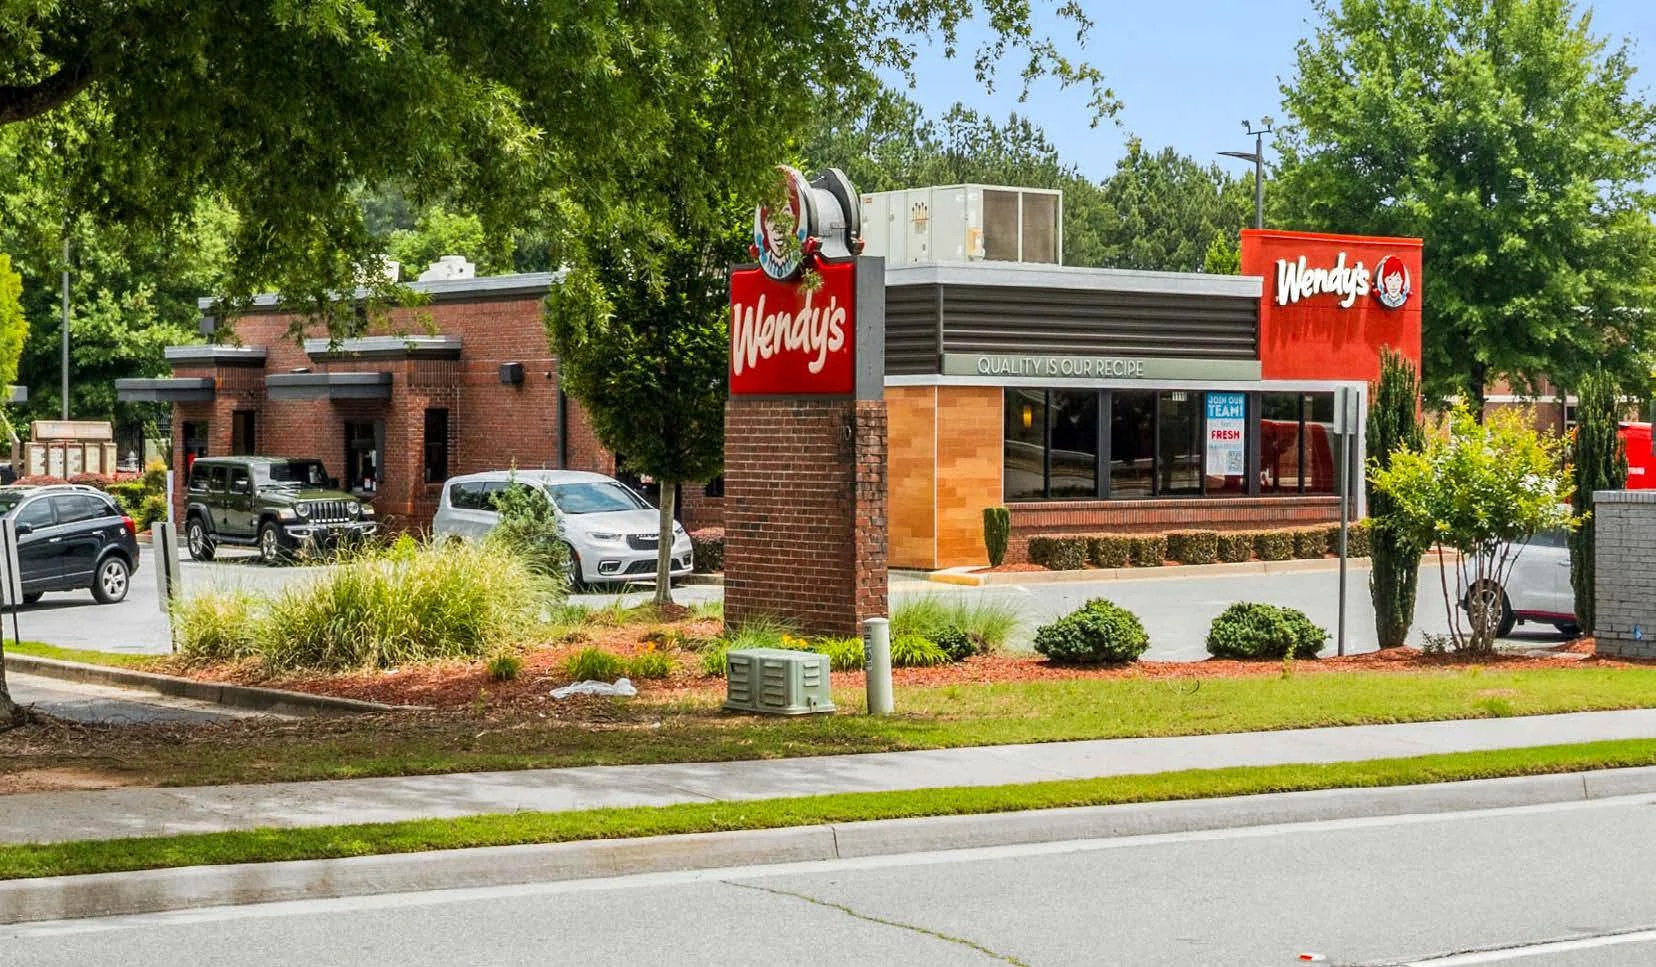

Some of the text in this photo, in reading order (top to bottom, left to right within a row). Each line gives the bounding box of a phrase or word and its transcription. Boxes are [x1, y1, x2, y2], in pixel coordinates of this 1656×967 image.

[1277, 252, 1370, 308] Wendy's
[733, 288, 846, 376] Wendy's
[977, 356, 1144, 376] QUALITY IS OUR RECIPE
[1208, 395, 1243, 404] JOIN OUR
[1208, 404, 1243, 417] TEAM!
[1211, 430, 1240, 440] FRESH
